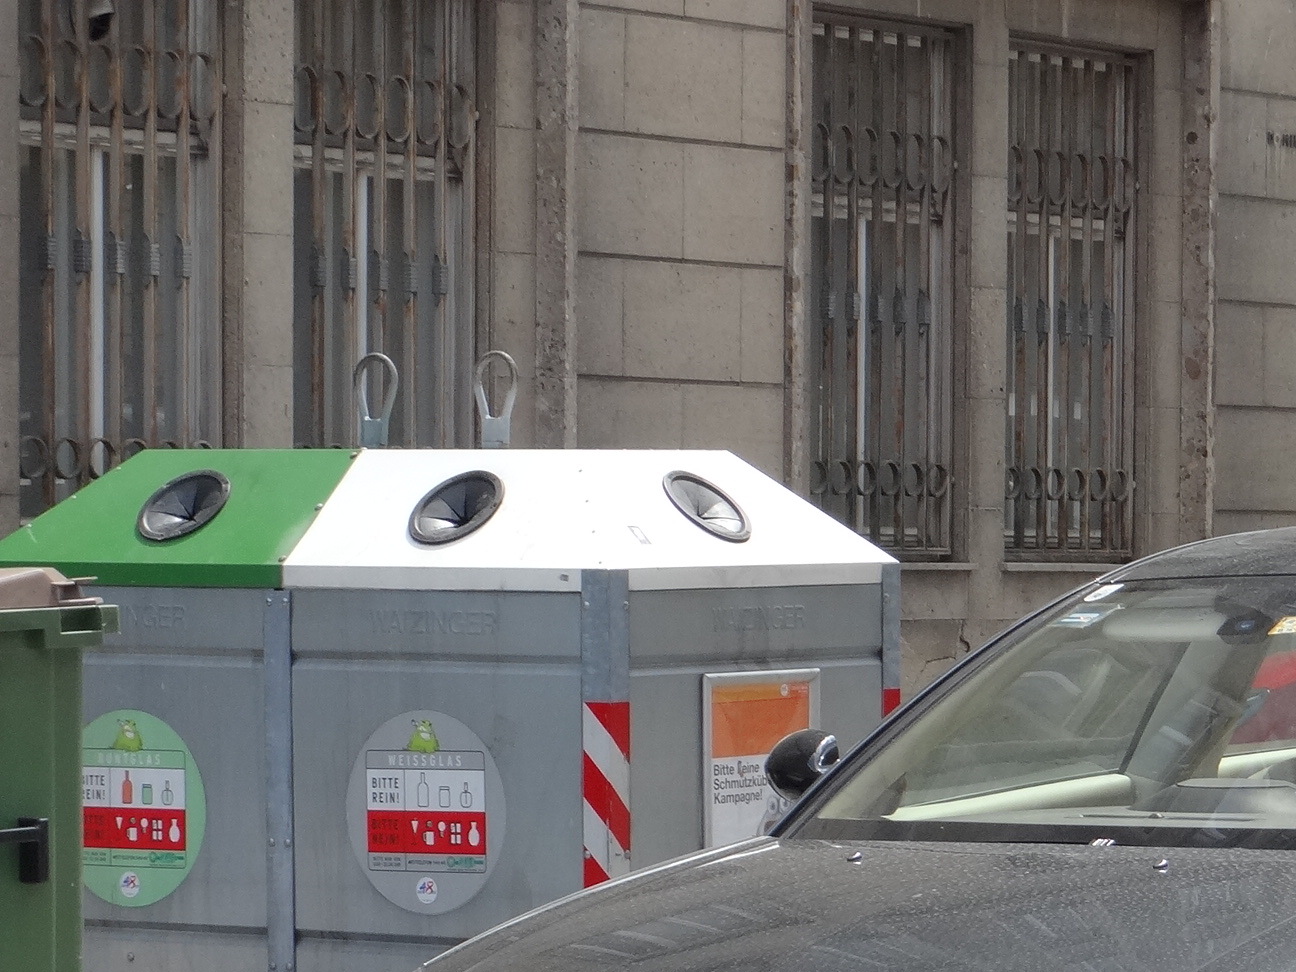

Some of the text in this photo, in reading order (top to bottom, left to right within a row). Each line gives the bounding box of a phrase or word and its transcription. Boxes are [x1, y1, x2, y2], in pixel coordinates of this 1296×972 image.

[387, 754, 463, 767] WEISSGLAS
[713, 764, 735, 776] Bitte
[371, 777, 400, 789] BITTE
[713, 775, 768, 791] Schmutzküb
[371, 791, 400, 804] REIN!
[713, 788, 763, 805] Kampagne!
